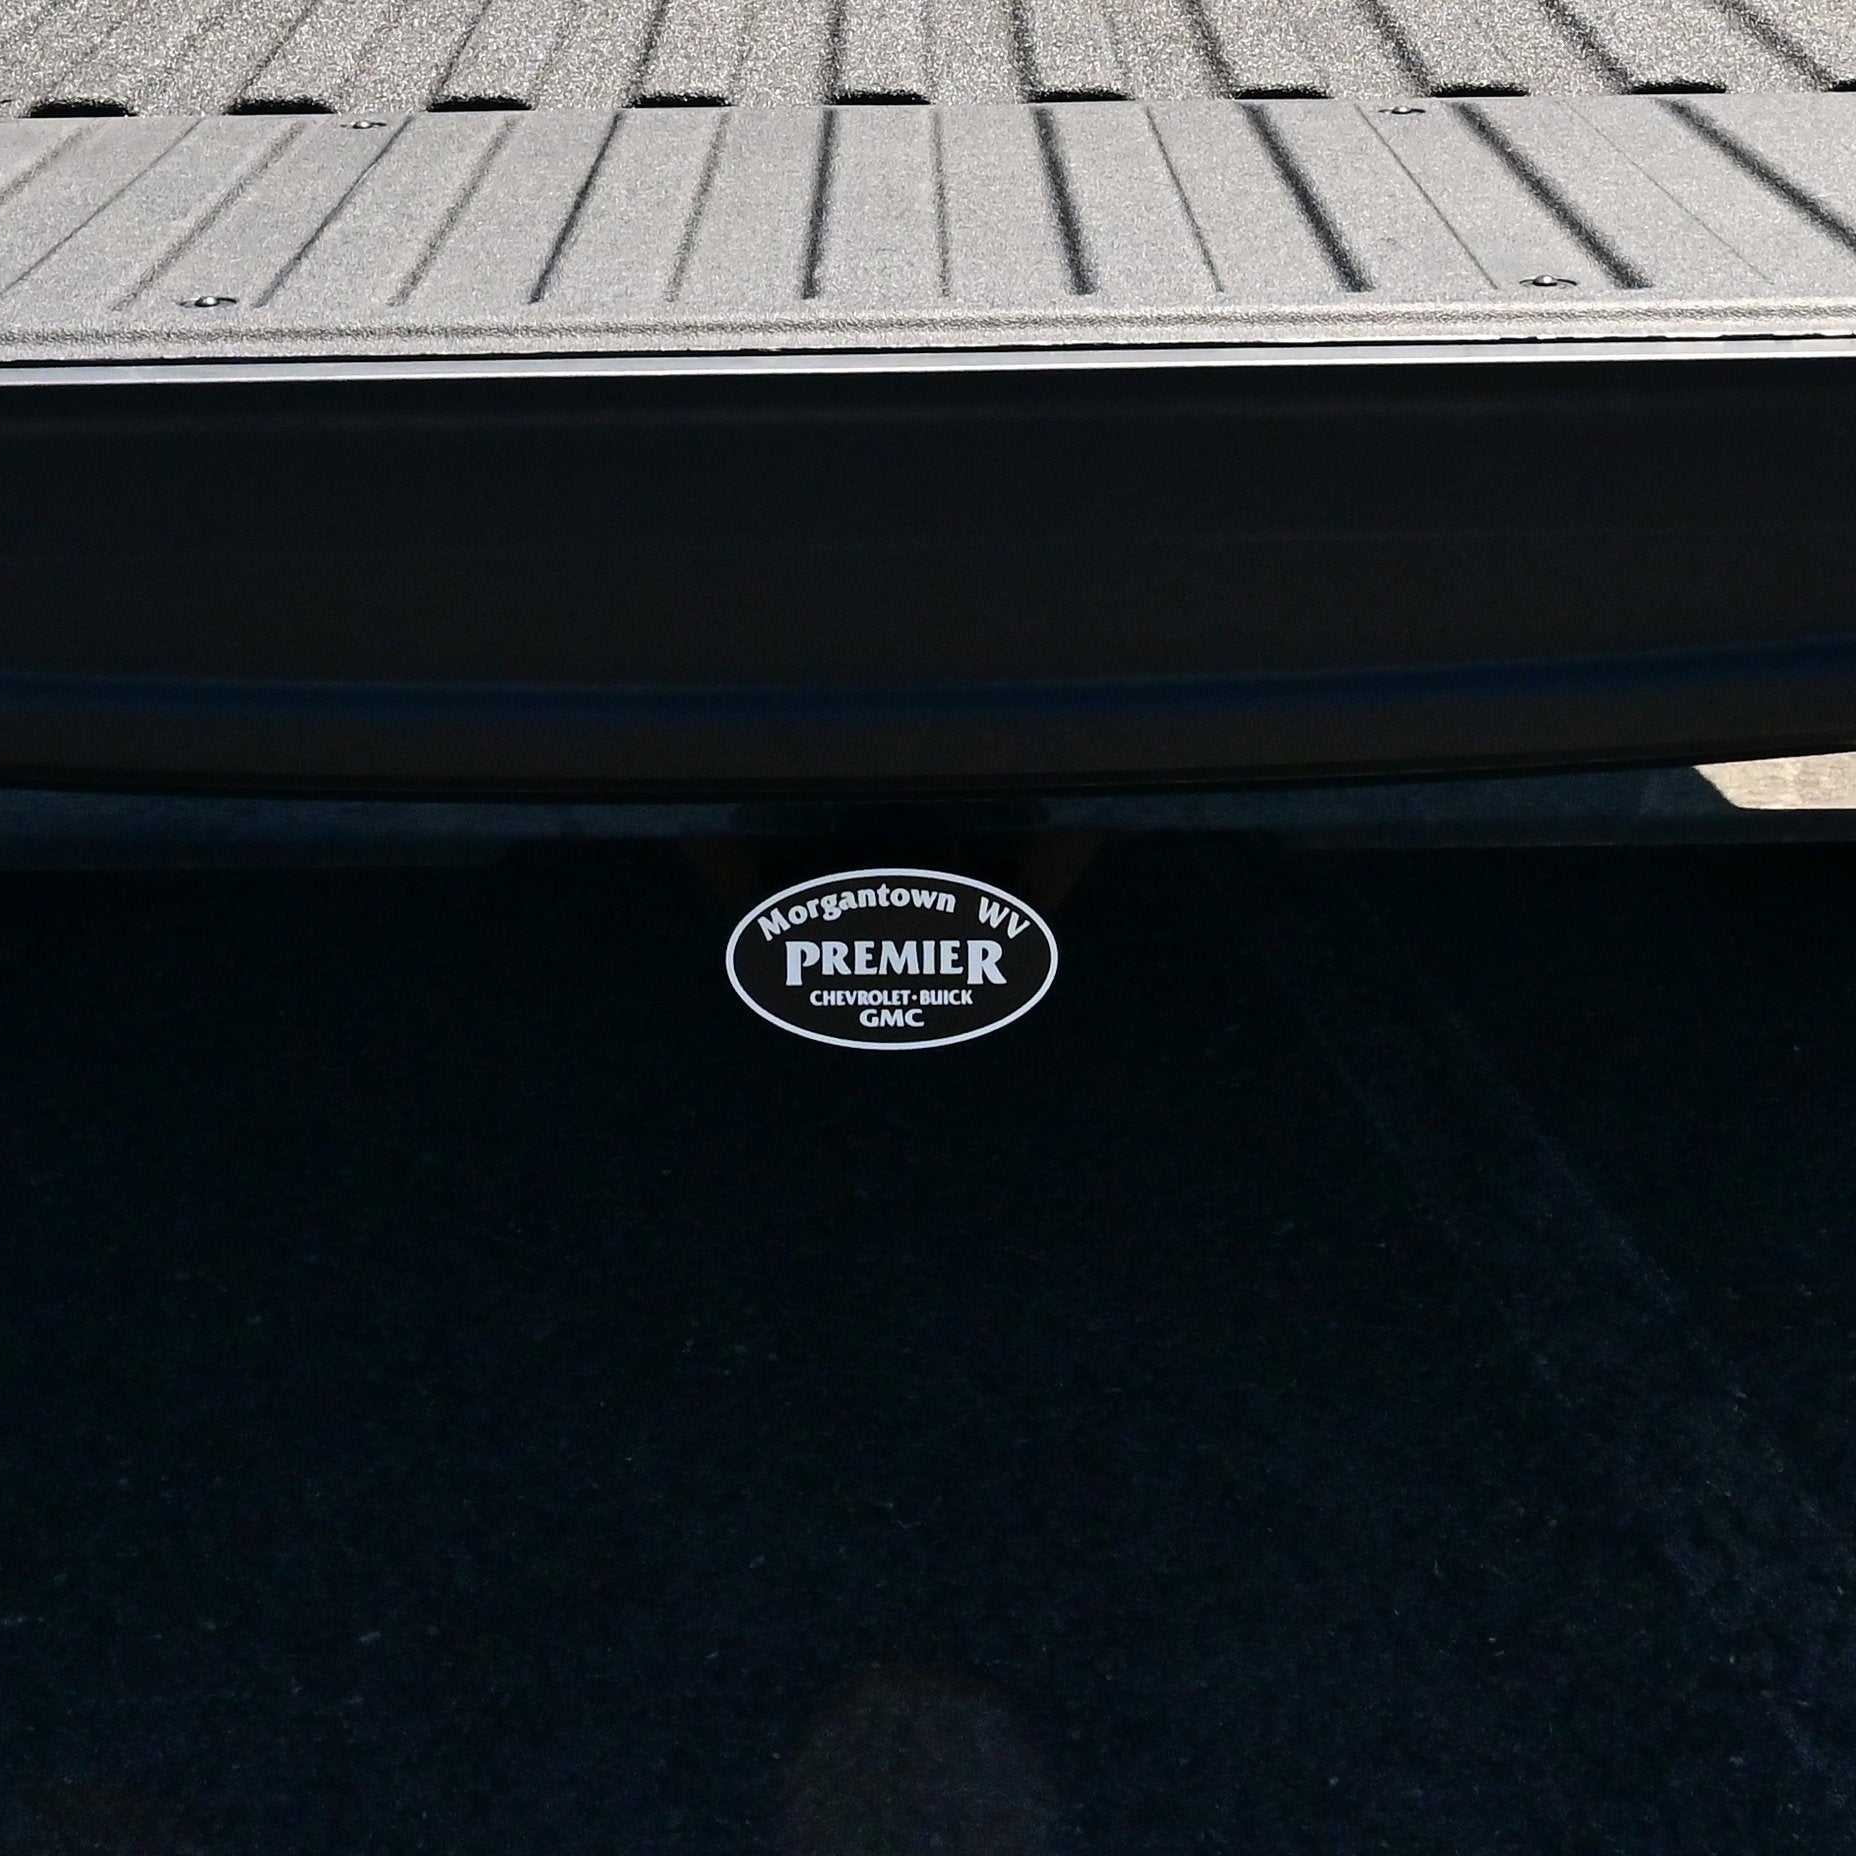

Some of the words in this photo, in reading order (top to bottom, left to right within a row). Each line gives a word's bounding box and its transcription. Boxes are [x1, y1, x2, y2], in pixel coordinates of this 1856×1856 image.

[757, 882, 957, 942] Morgantown
[977, 896, 1031, 940] WV
[784, 939, 1008, 987] PREMIER
[858, 1008, 926, 1028] GMC
